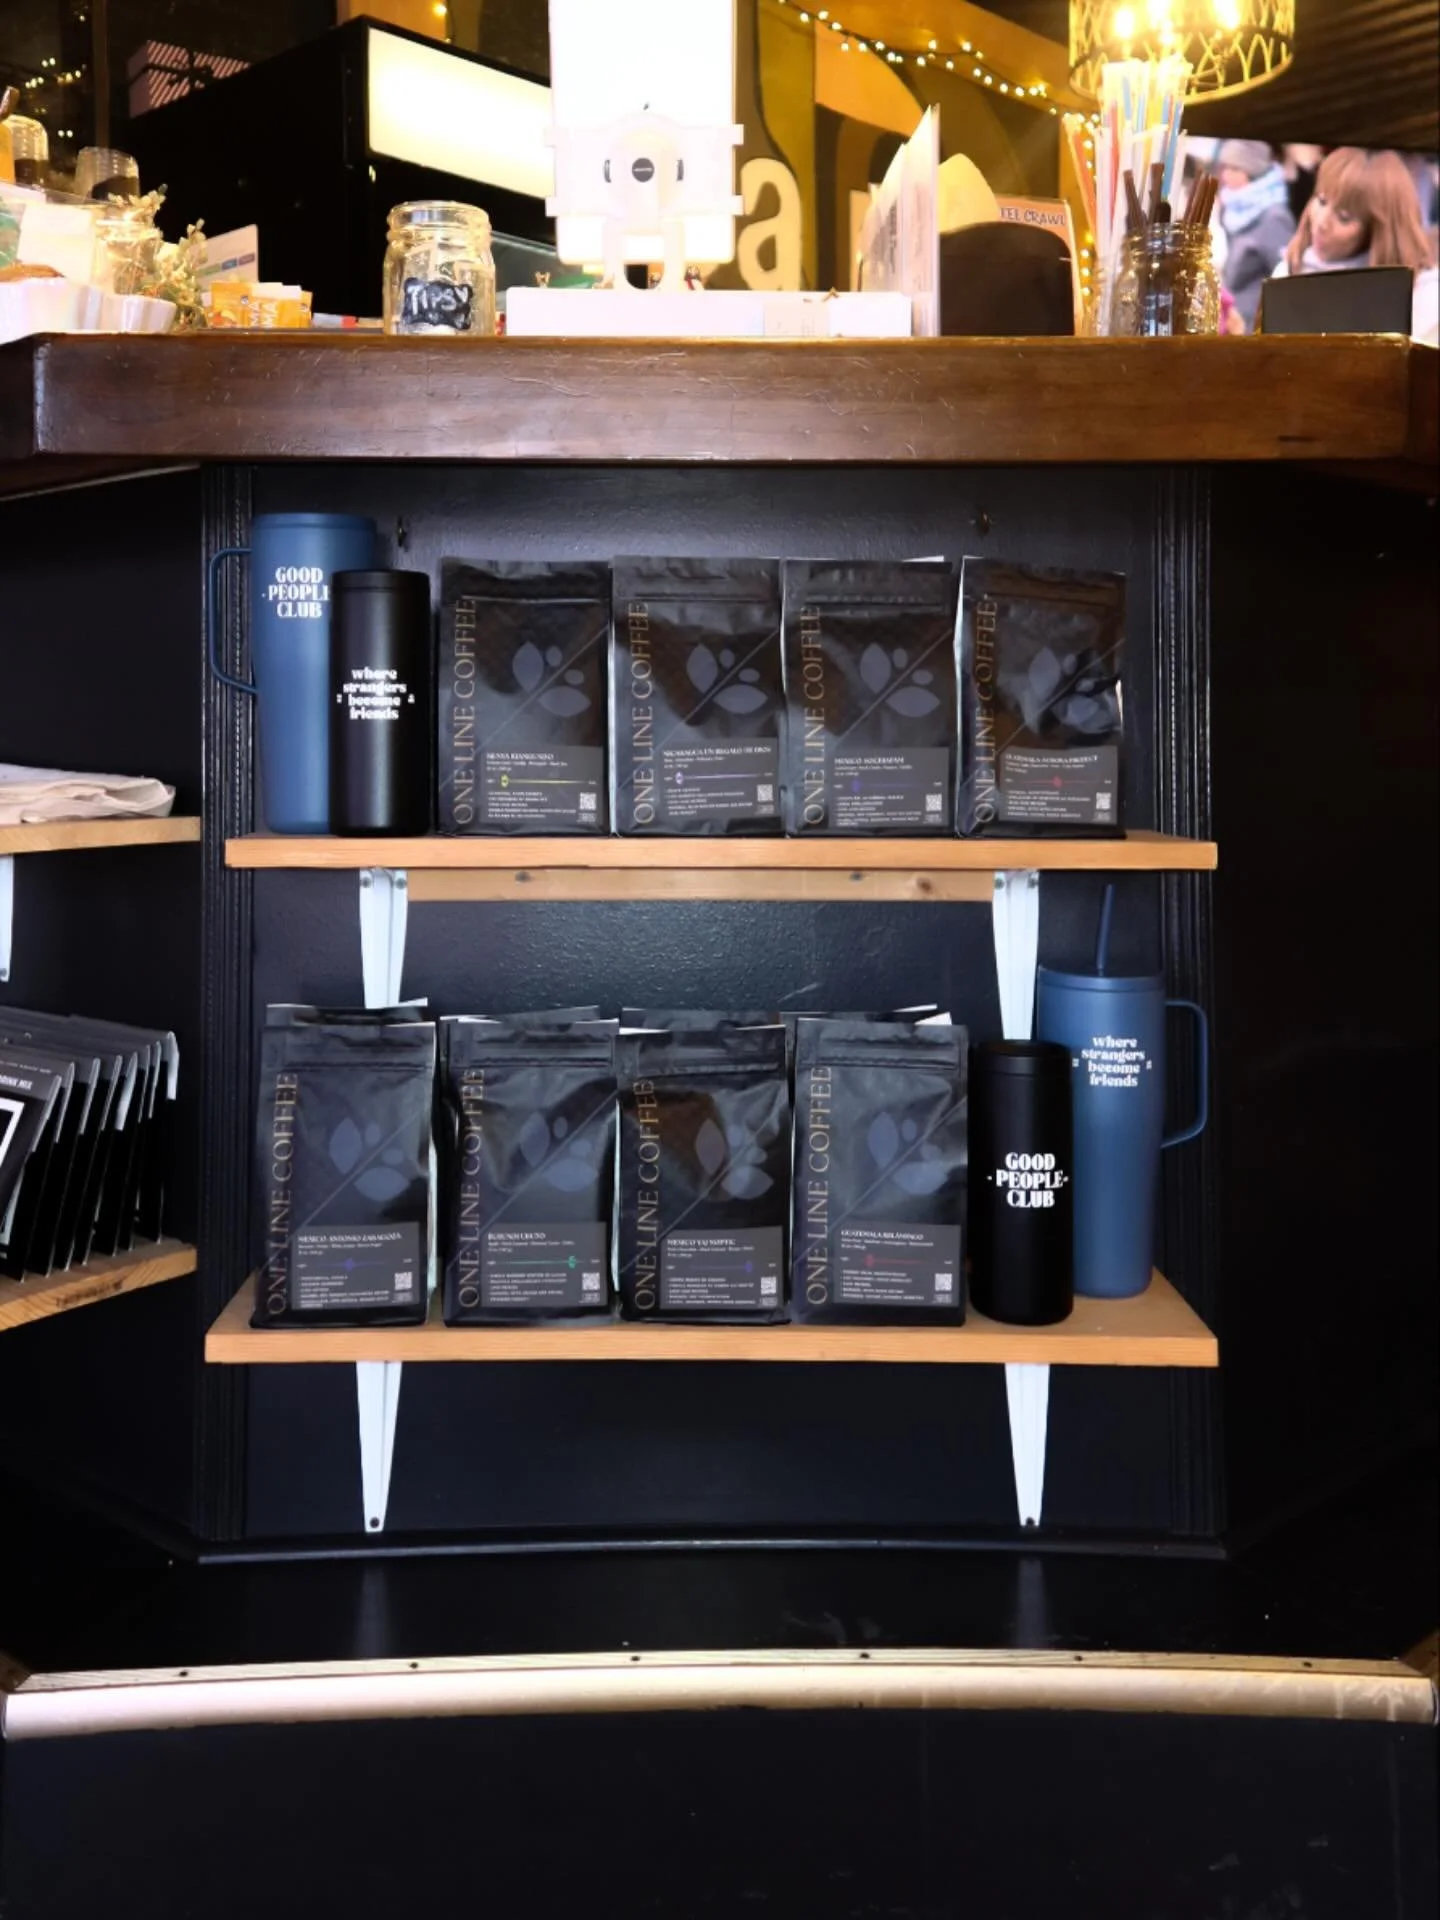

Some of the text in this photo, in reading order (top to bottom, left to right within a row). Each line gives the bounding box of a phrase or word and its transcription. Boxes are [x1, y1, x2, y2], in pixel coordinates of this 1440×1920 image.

[275, 566, 323, 584] GOOD
[277, 602, 322, 618] CLUB
[352, 667, 397, 680] where
[343, 681, 407, 696] strangers
[348, 694, 401, 706] become
[350, 707, 399, 720] friends
[453, 600, 476, 824] ONE LINE COFFEE
[629, 602, 655, 824] ONE LINE COFFEE
[800, 605, 825, 824] ONE LINE COFFEE
[975, 706, 996, 762] LINE
[974, 769, 995, 823] ONE
[1092, 1035, 1137, 1048] where
[1081, 1049, 1145, 1063] strangers
[1088, 1060, 1140, 1074] become
[1090, 1074, 1138, 1087] friends
[1005, 1152, 1055, 1170] GOOD
[459, 1069, 484, 1308] ONE LINE COFFEE
[806, 1067, 832, 1305] ONE LINE COFFEE
[996, 1169, 1064, 1189] PEOPLE
[267, 1072, 297, 1314] ONE LINE COFFEE
[1006, 1189, 1055, 1208] CLUB
[636, 1190, 659, 1247] LINE
[635, 1255, 656, 1311] ONE
